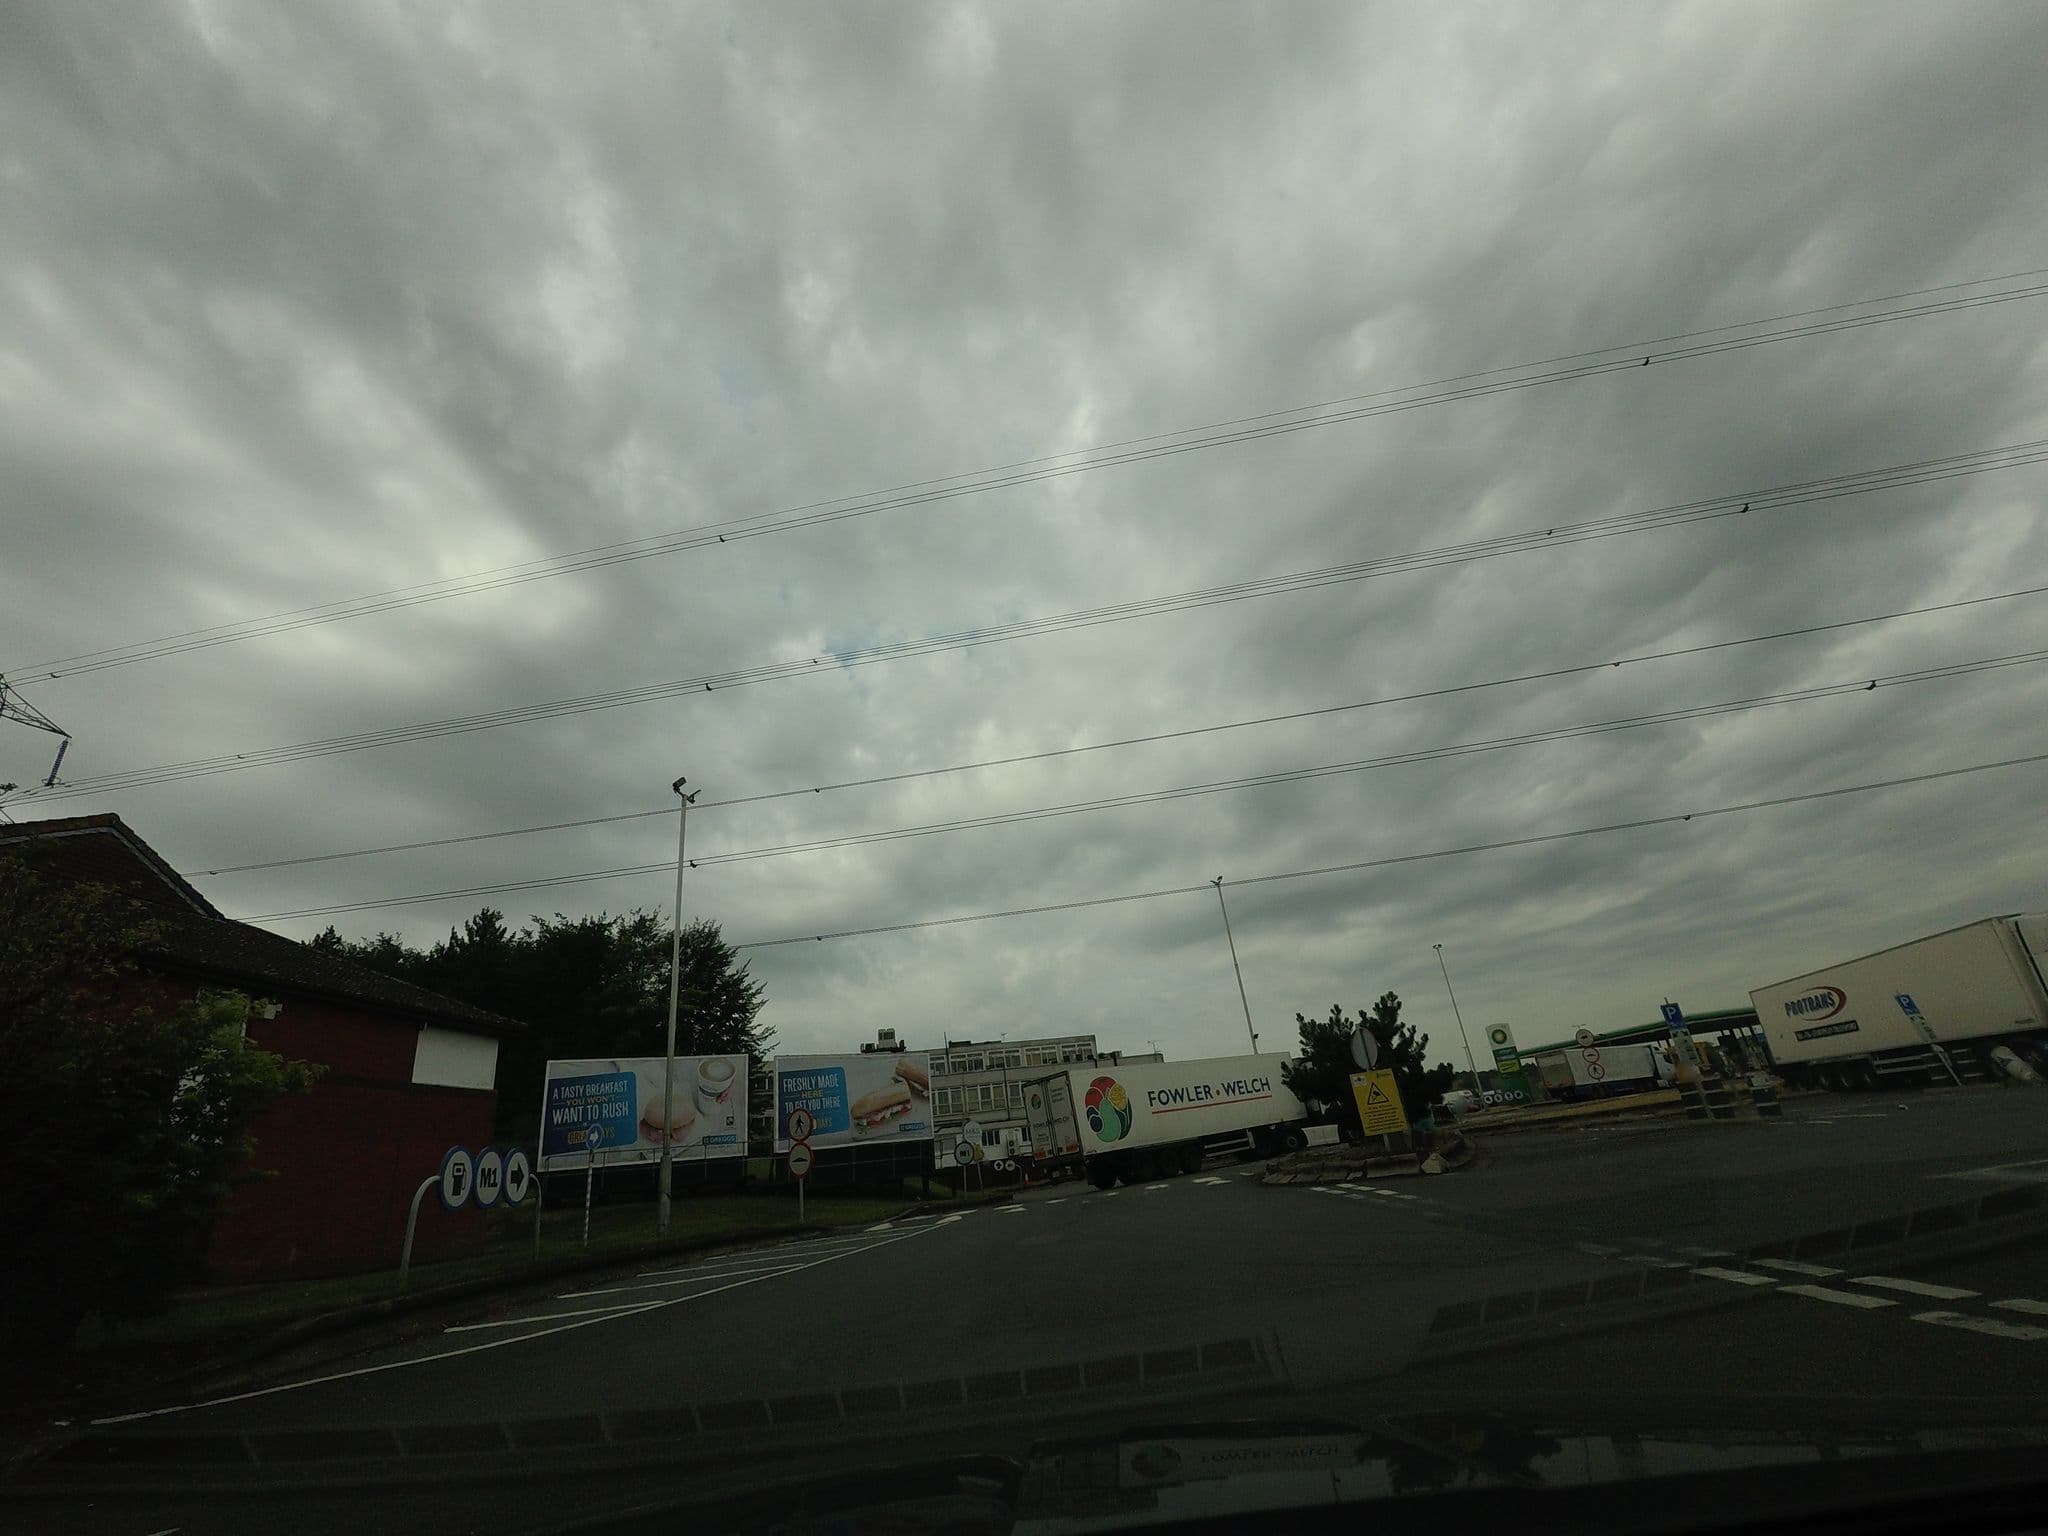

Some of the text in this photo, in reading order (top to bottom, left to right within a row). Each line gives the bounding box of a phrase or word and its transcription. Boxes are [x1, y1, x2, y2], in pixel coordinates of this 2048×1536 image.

[1784, 991, 1836, 1017] PROTRANS
[1900, 997, 1909, 1008] P
[1666, 1007, 1676, 1020] P
[553, 1080, 629, 1100] A TASTY BREAKFAST
[783, 1073, 839, 1093] FRESHLY MADE
[1147, 1077, 1271, 1107] FOWLER WELCH
[566, 1098, 584, 1106] YOU
[801, 1090, 824, 1098] HERE
[553, 1101, 629, 1126] WANT TO RUSH
[785, 1102, 794, 1114] TO
[808, 1098, 821, 1111] YOU
[822, 1096, 841, 1109] THERE
[480, 1167, 498, 1188] M1
